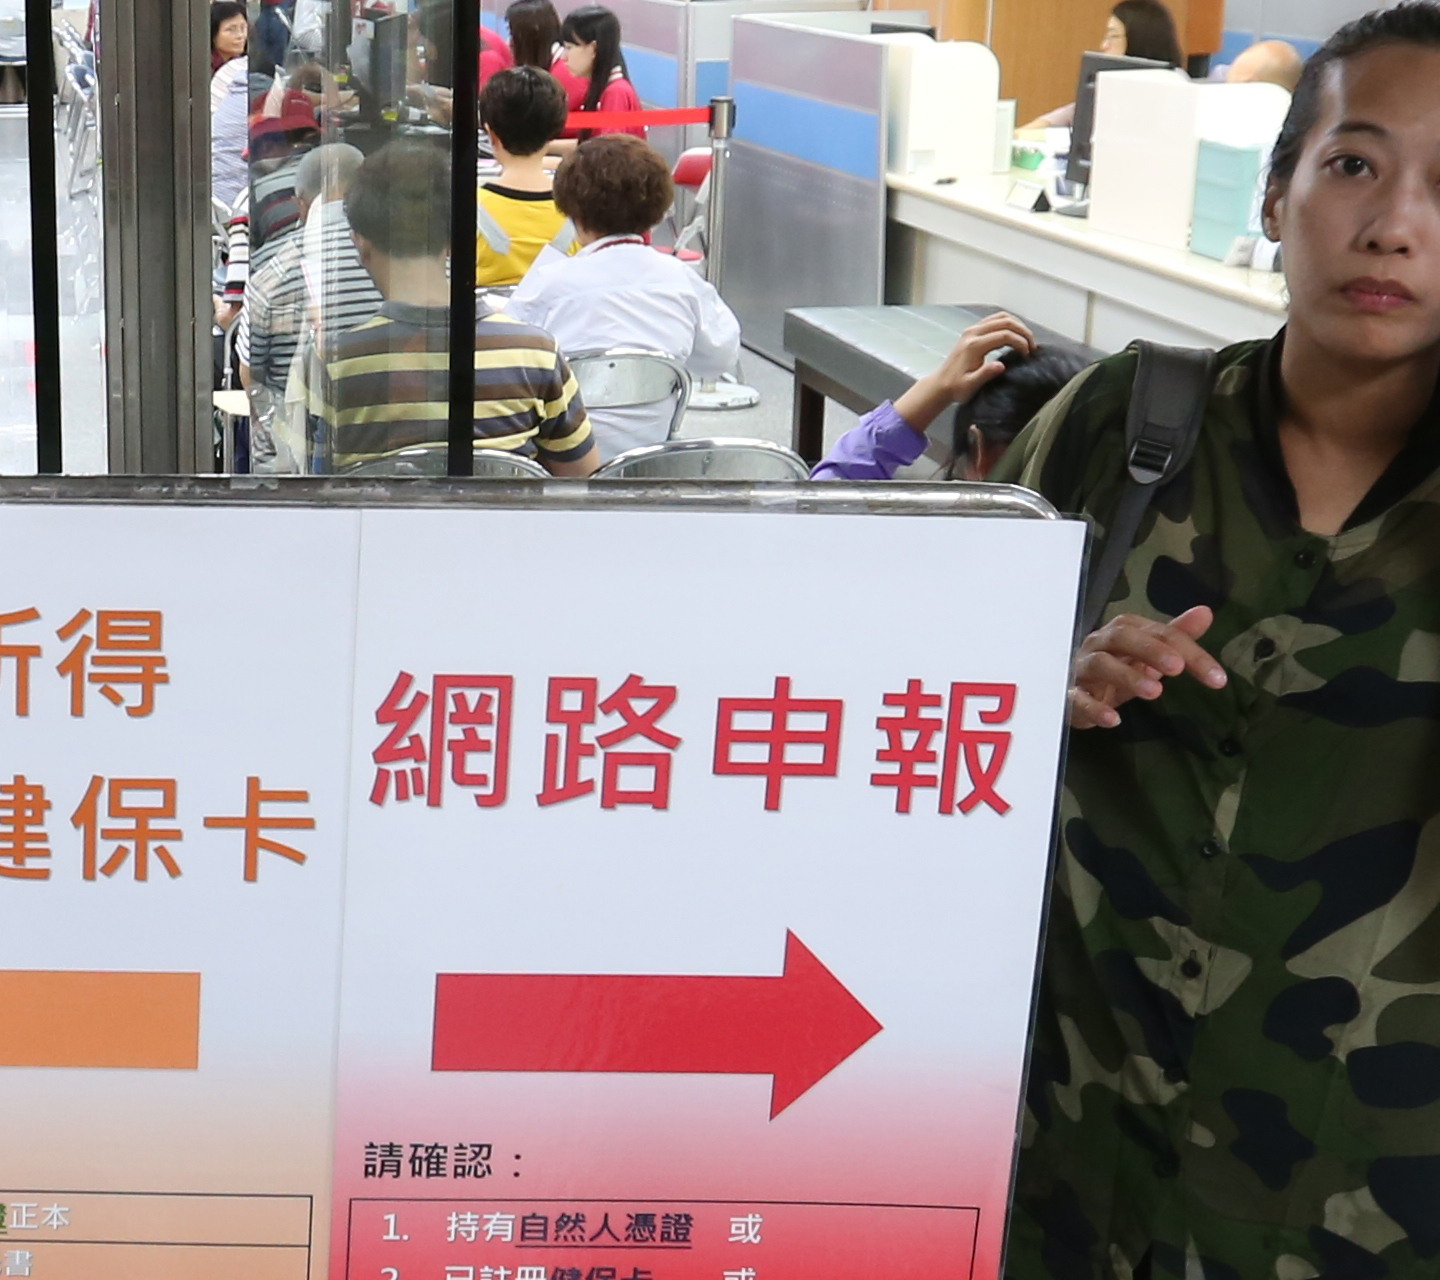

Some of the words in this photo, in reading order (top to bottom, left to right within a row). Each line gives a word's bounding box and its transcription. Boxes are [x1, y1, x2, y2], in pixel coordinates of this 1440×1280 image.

[368, 670, 1018, 816] 網路申報
[380, 1213, 411, 1243] 1.
[445, 1210, 695, 1245] 持有自然人憑證
[727, 1213, 765, 1245] 或
